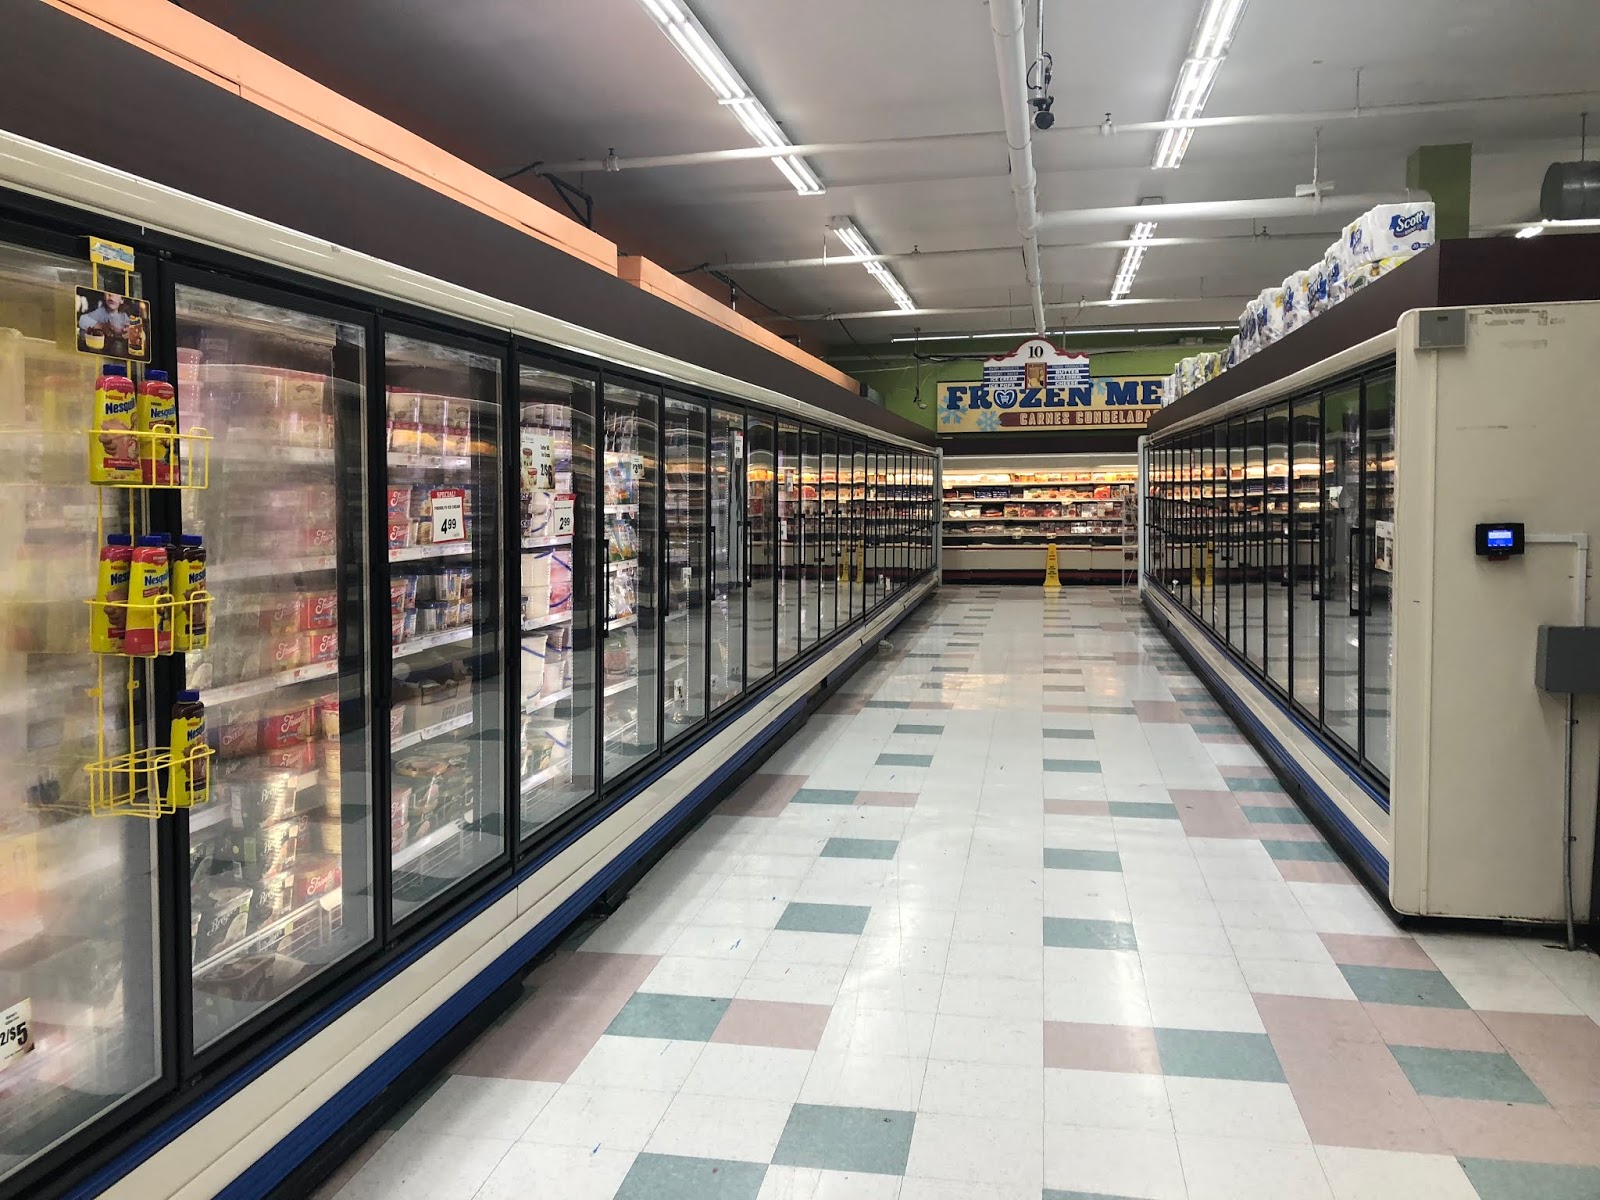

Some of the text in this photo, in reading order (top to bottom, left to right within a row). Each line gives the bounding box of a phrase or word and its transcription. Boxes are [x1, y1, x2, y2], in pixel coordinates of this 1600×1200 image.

[1395, 211, 1425, 232] Scott
[1028, 346, 1044, 359] 10
[946, 380, 1162, 410] FROZEN ME
[1019, 409, 1158, 425] CARNES CONGELADA
